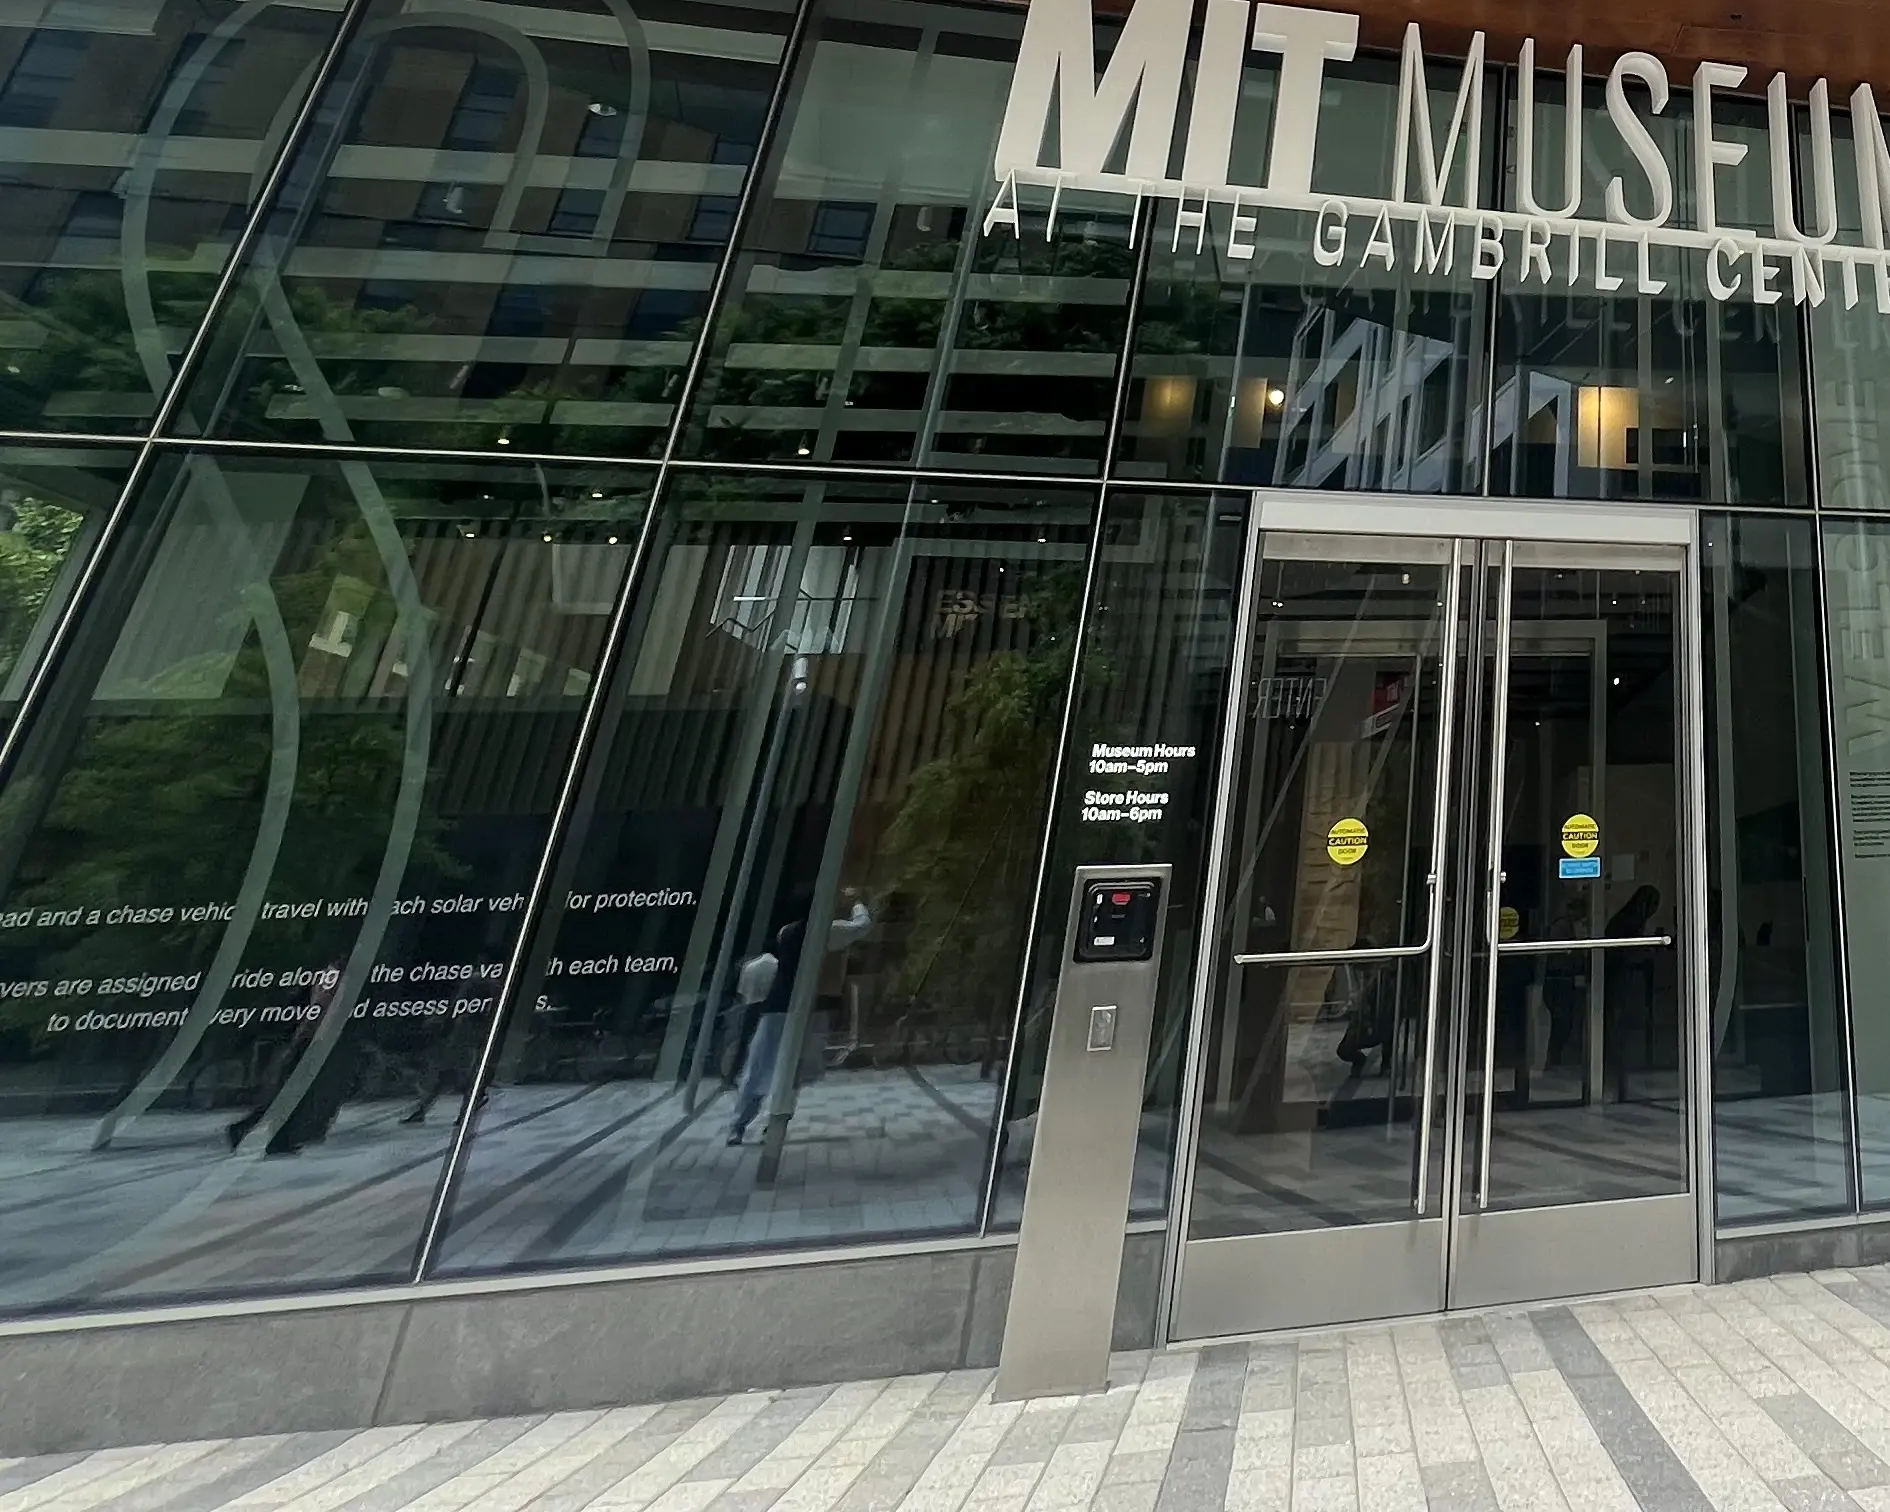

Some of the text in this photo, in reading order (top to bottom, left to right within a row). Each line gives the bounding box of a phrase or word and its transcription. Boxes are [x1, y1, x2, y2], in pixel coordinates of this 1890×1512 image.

[1128, 178, 1257, 260] THE
[1314, 200, 1666, 293] GAMBRILL
[1092, 743, 1196, 758] Museum Hours
[1084, 790, 1169, 805] Store Hours
[1328, 837, 1367, 845] CAUTION
[1563, 832, 1597, 840] CAUTION
[0, 907, 35, 928] ad
[37, 906, 84, 927] and
[86, 908, 101, 925] a
[106, 904, 174, 924] chase
[181, 901, 236, 922] vehic
[261, 899, 323, 920] travel
[327, 897, 369, 917] with
[391, 895, 426, 916] ach
[430, 894, 484, 914] solar
[594, 888, 697, 913] protection.
[0, 980, 49, 999] vers
[54, 978, 93, 996] are
[97, 971, 202, 997] assigned
[231, 968, 275, 988] ride
[279, 966, 340, 990] along
[370, 964, 404, 984] the
[409, 961, 473, 982] chase
[480, 962, 504, 979] va
[569, 954, 619, 976] each
[625, 955, 679, 974] team,
[47, 1012, 70, 1032] to
[75, 1007, 189, 1031] document
[208, 1007, 257, 1029] very
[260, 1004, 322, 1022] move
[372, 999, 449, 1018] assess
